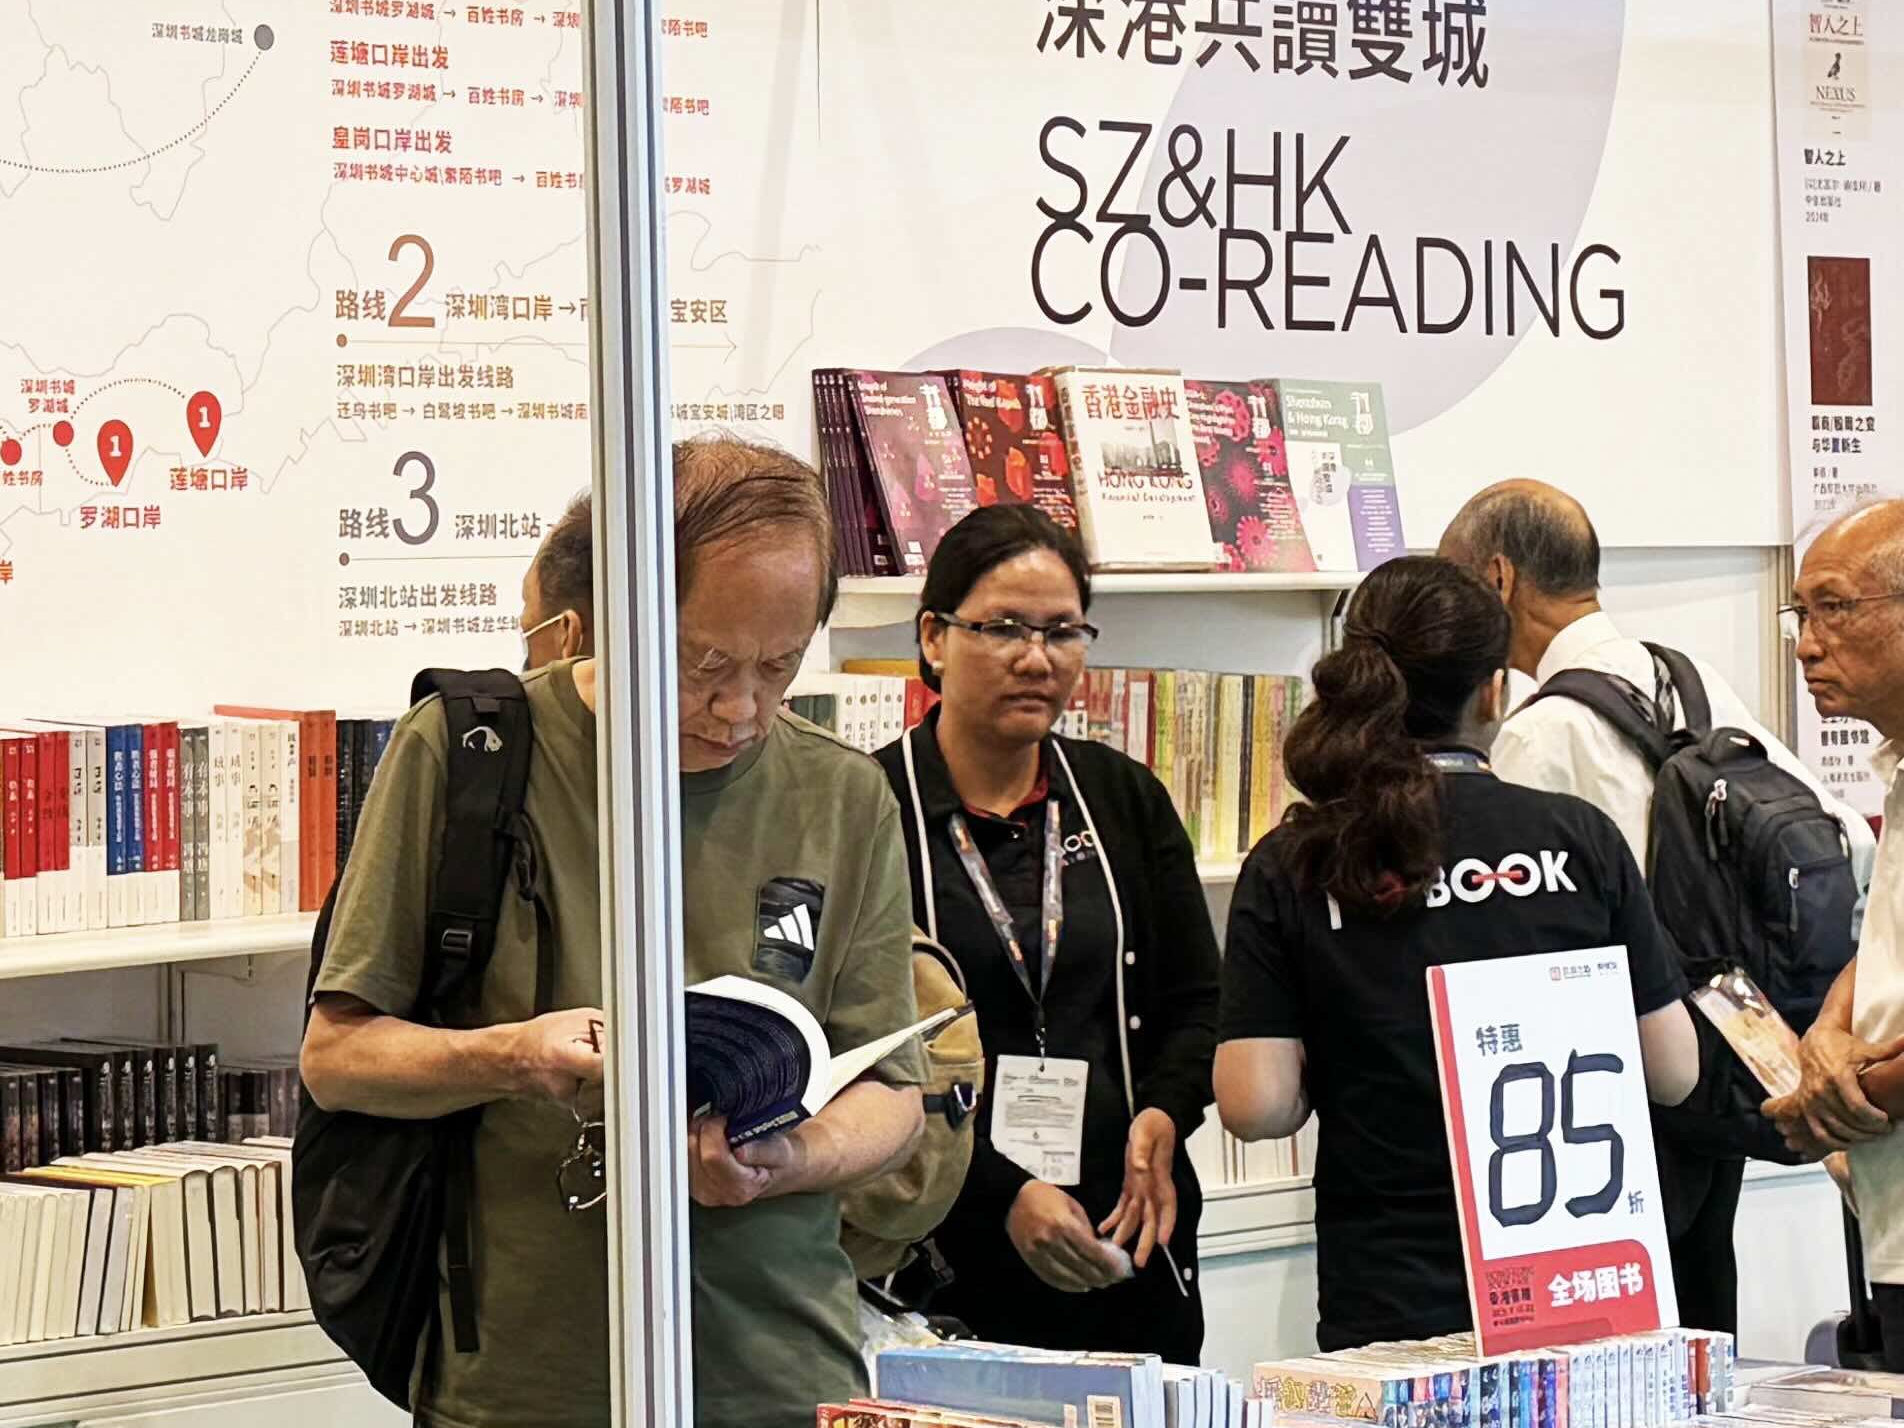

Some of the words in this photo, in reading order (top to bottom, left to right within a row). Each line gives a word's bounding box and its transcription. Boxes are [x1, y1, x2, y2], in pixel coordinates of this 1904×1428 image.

[330, 40, 449, 69] 莲塘口岸出发
[1816, 85, 1856, 102] NEXUS
[332, 126, 452, 153] 皇岗口岸出发
[1037, 116, 1352, 235] SZ&HK
[336, 289, 387, 321] 路线
[388, 234, 436, 328] 2
[445, 293, 553, 321] 深圳湾口岸
[1030, 218, 1625, 341] CO-READING
[336, 364, 514, 389] 深圳湾口岸出发线路
[197, 403, 210, 428] 1
[1082, 384, 1181, 421] 香港金融史
[109, 433, 121, 458] 1
[168, 466, 248, 492] 莲塘口岸
[338, 508, 390, 540] 路线
[392, 450, 440, 546] 3
[455, 512, 542, 540] 深圳北站
[79, 505, 162, 531] 罗湖口岸
[338, 583, 497, 610] 深圳北站出发线路
[1476, 1023, 1523, 1058] 特惠
[1489, 1049, 1625, 1228] 85
[1548, 1262, 1644, 1310] 全场图书
